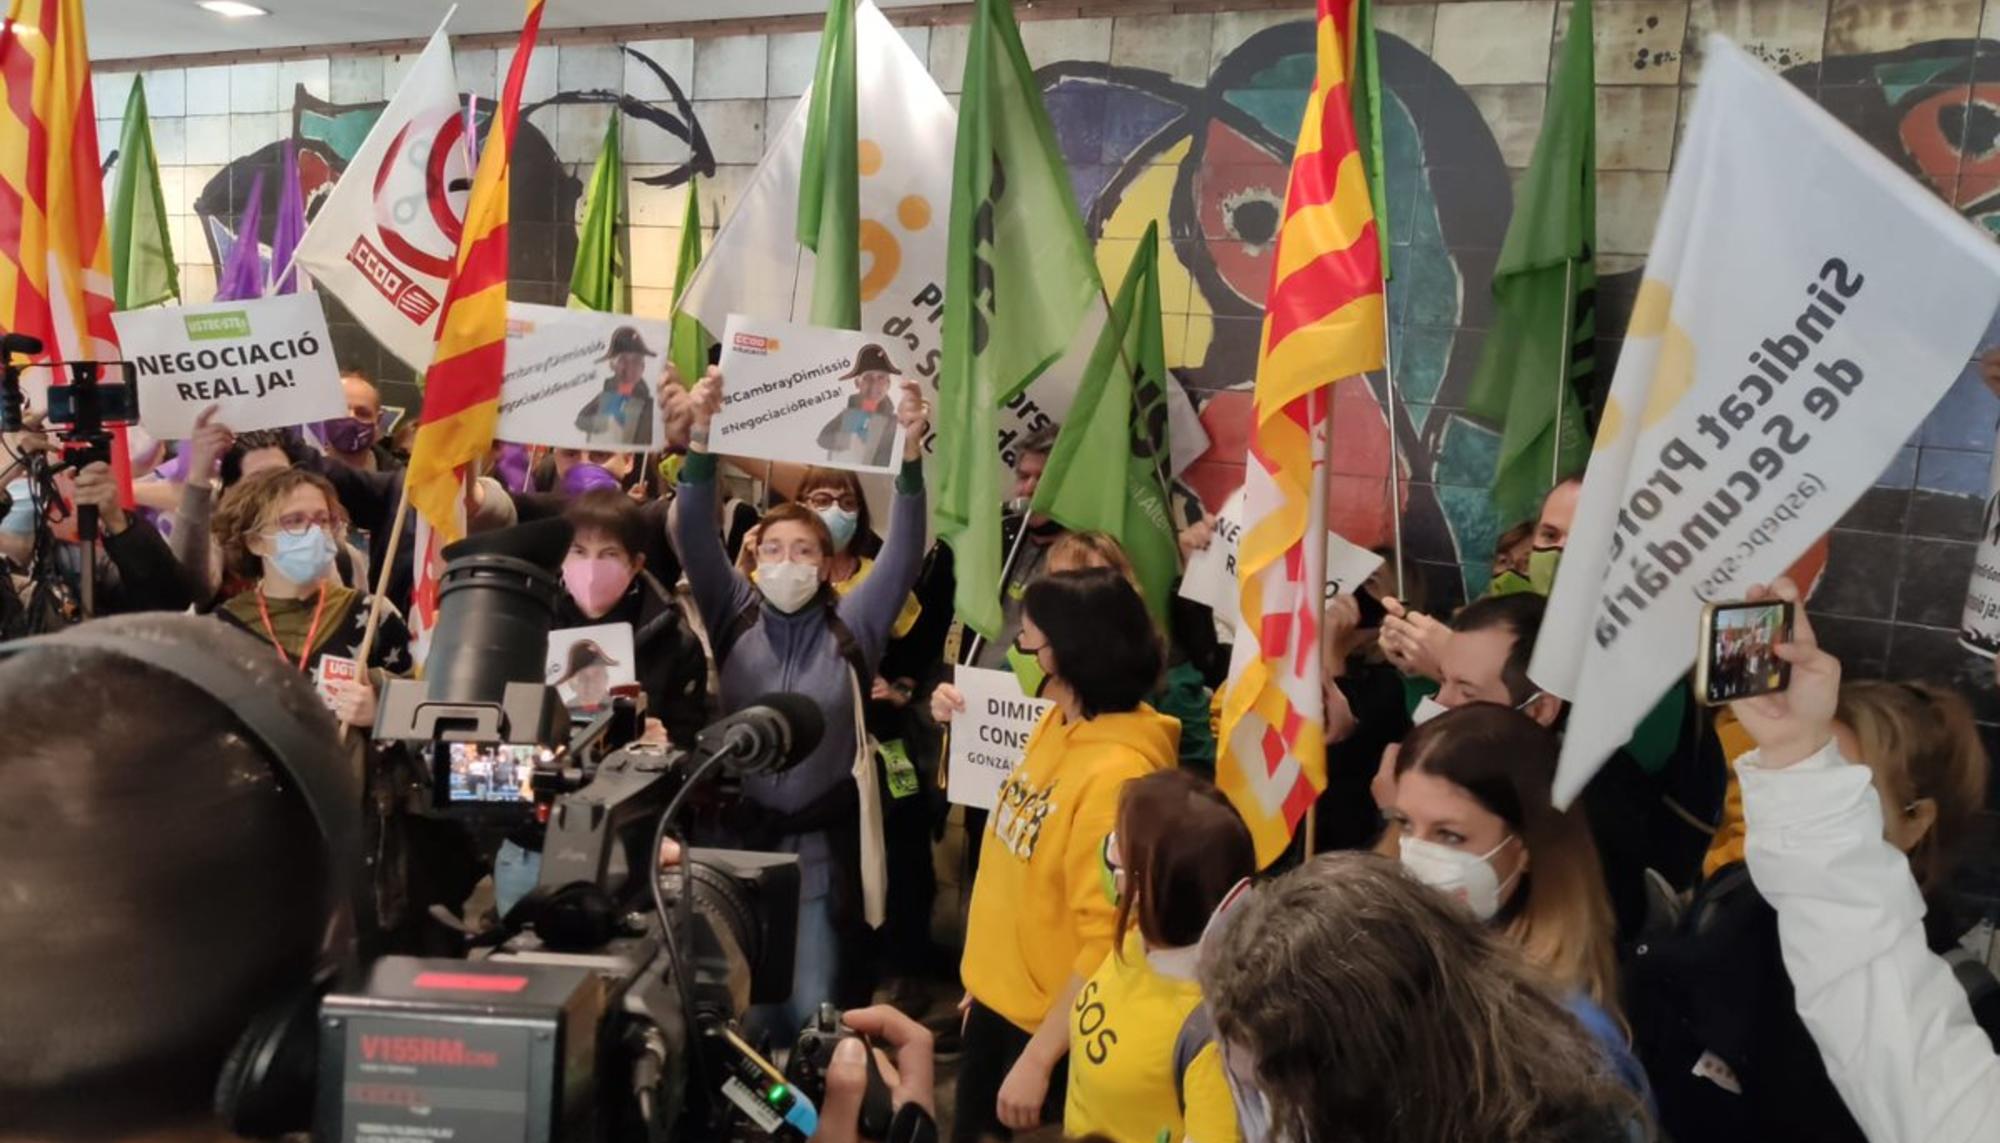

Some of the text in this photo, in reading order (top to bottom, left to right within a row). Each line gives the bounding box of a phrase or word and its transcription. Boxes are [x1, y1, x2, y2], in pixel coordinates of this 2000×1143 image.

[136, 331, 319, 376] NEGOCIACIÓ
[177, 369, 297, 401] REAL JA!
[724, 357, 851, 406] #CambrayDimissió
[720, 386, 843, 436] #NegociacióRealJa!
[1076, 981, 1118, 1066] SOS
